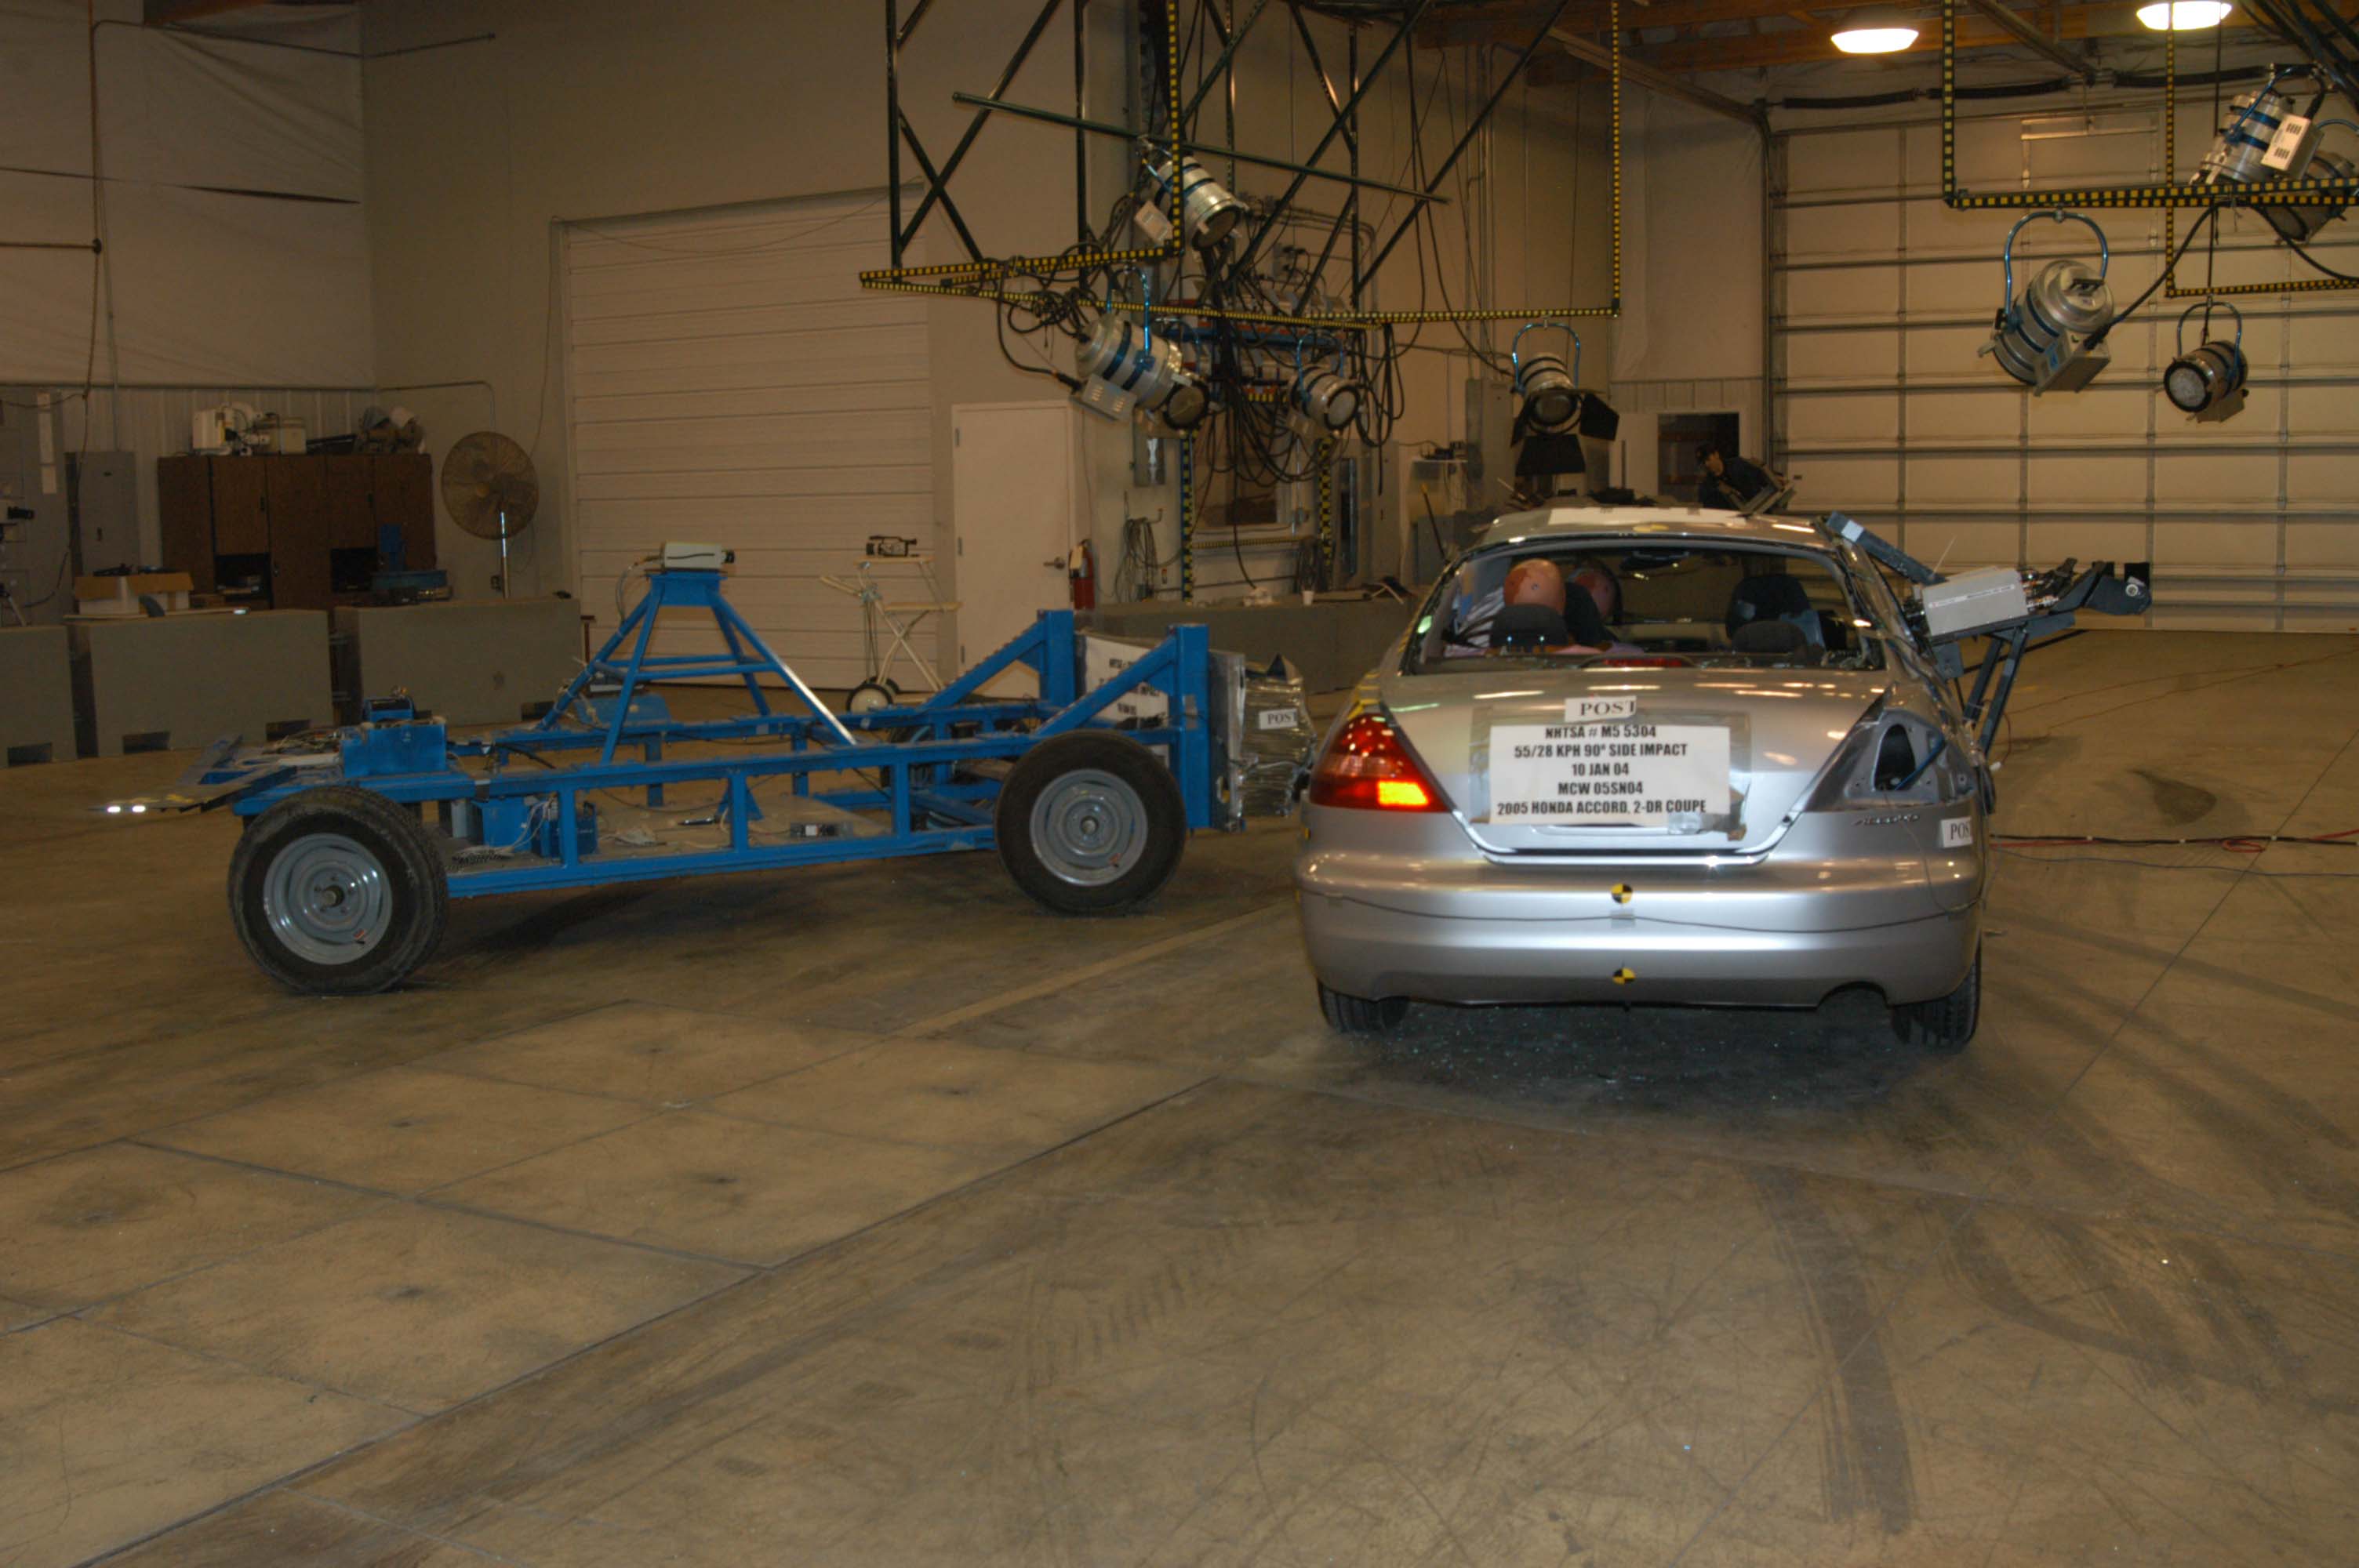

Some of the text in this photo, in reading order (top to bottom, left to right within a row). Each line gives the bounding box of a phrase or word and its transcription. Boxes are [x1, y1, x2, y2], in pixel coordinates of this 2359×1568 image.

[1546, 724, 1656, 739] NHTSA # M5 5304
[1514, 746, 1553, 758] 55/28
[1557, 745, 1580, 757] KPH
[1609, 744, 1637, 757] SIDE
[1640, 743, 1688, 756] IMPACT
[1572, 762, 1629, 775] 10 JAN 04
[1558, 782, 1643, 795] MCW 05SN04
[1497, 802, 1528, 815] 2005
[1532, 801, 1573, 814] HONDA
[1634, 800, 1663, 813] 2-DR
[1666, 800, 1707, 813] COUPE
